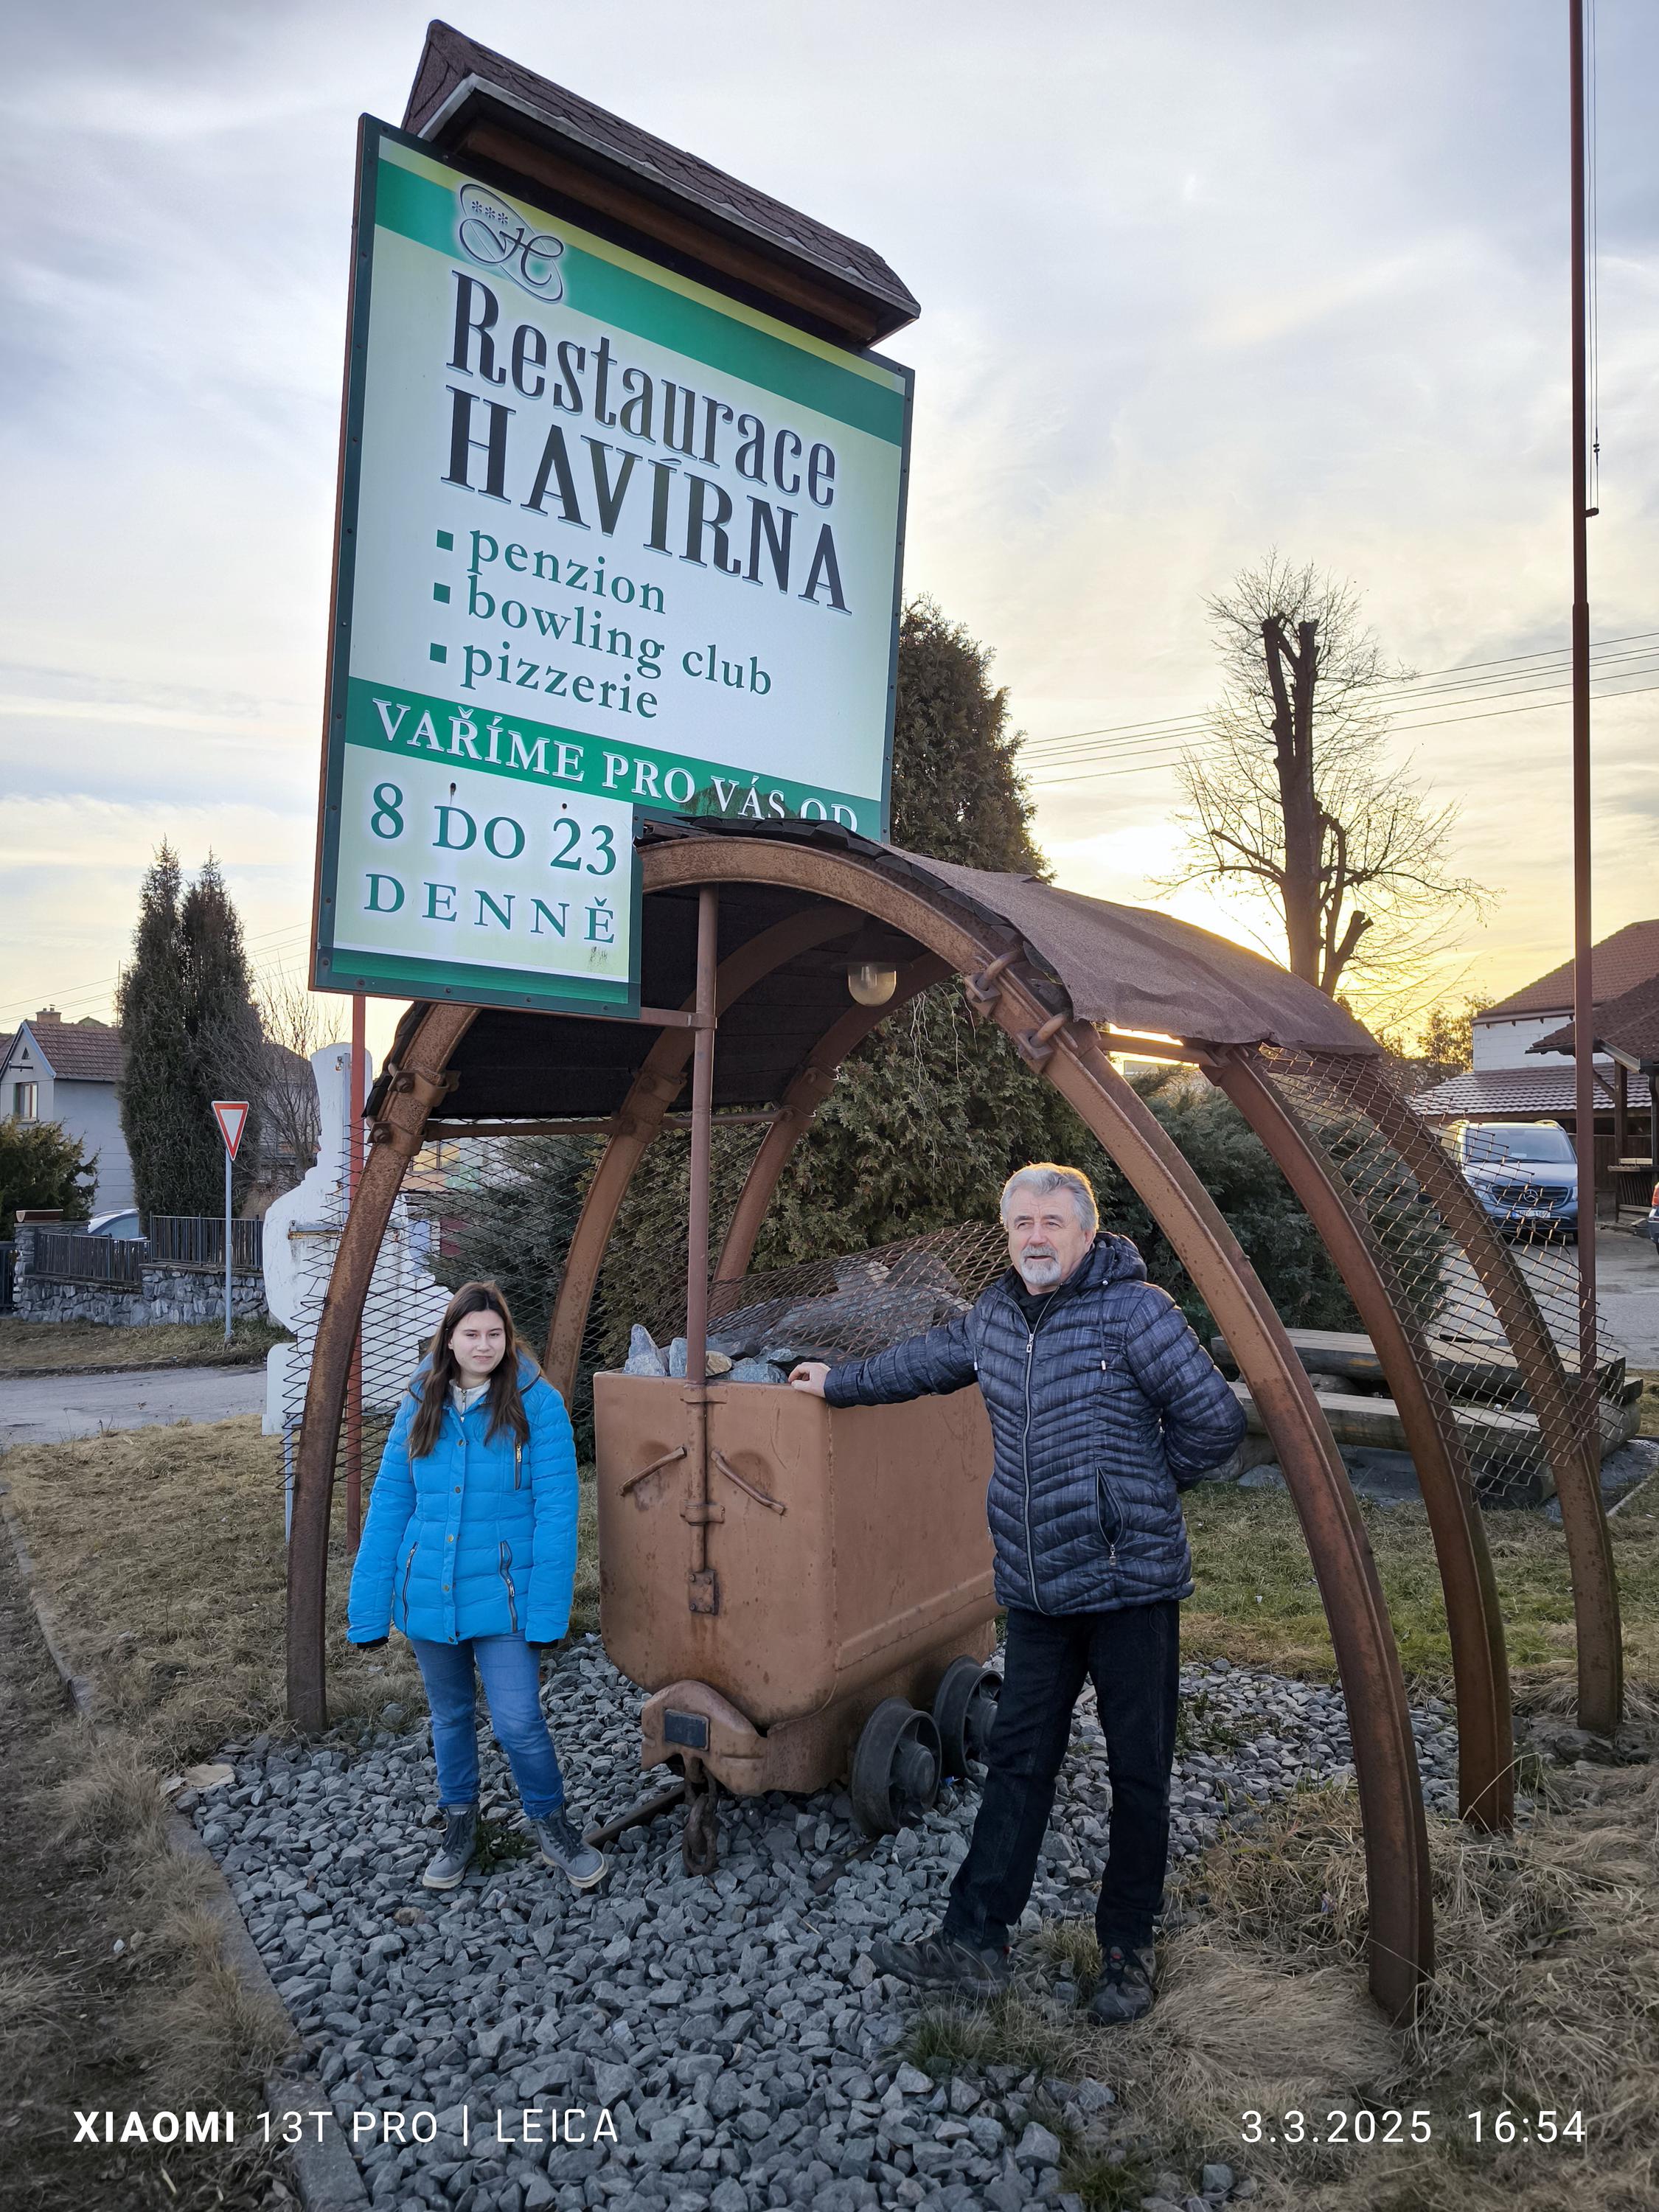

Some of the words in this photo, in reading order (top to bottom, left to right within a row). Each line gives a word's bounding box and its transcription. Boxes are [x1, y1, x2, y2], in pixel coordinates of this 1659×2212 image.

[446, 270, 835, 509] Restaurace
[441, 385, 852, 615] HAVÍRNA
[467, 530, 666, 614] penzion
[460, 641, 658, 718] pizzerie
[468, 574, 665, 679] bowling
[682, 644, 771, 695] club
[372, 698, 585, 783] VAŘÍME
[602, 751, 695, 804] PRO
[711, 775, 785, 819] VÁS
[371, 782, 404, 839] 8
[432, 805, 526, 860] DO
[550, 817, 616, 875] 23
[364, 873, 615, 944] DENNĚ
